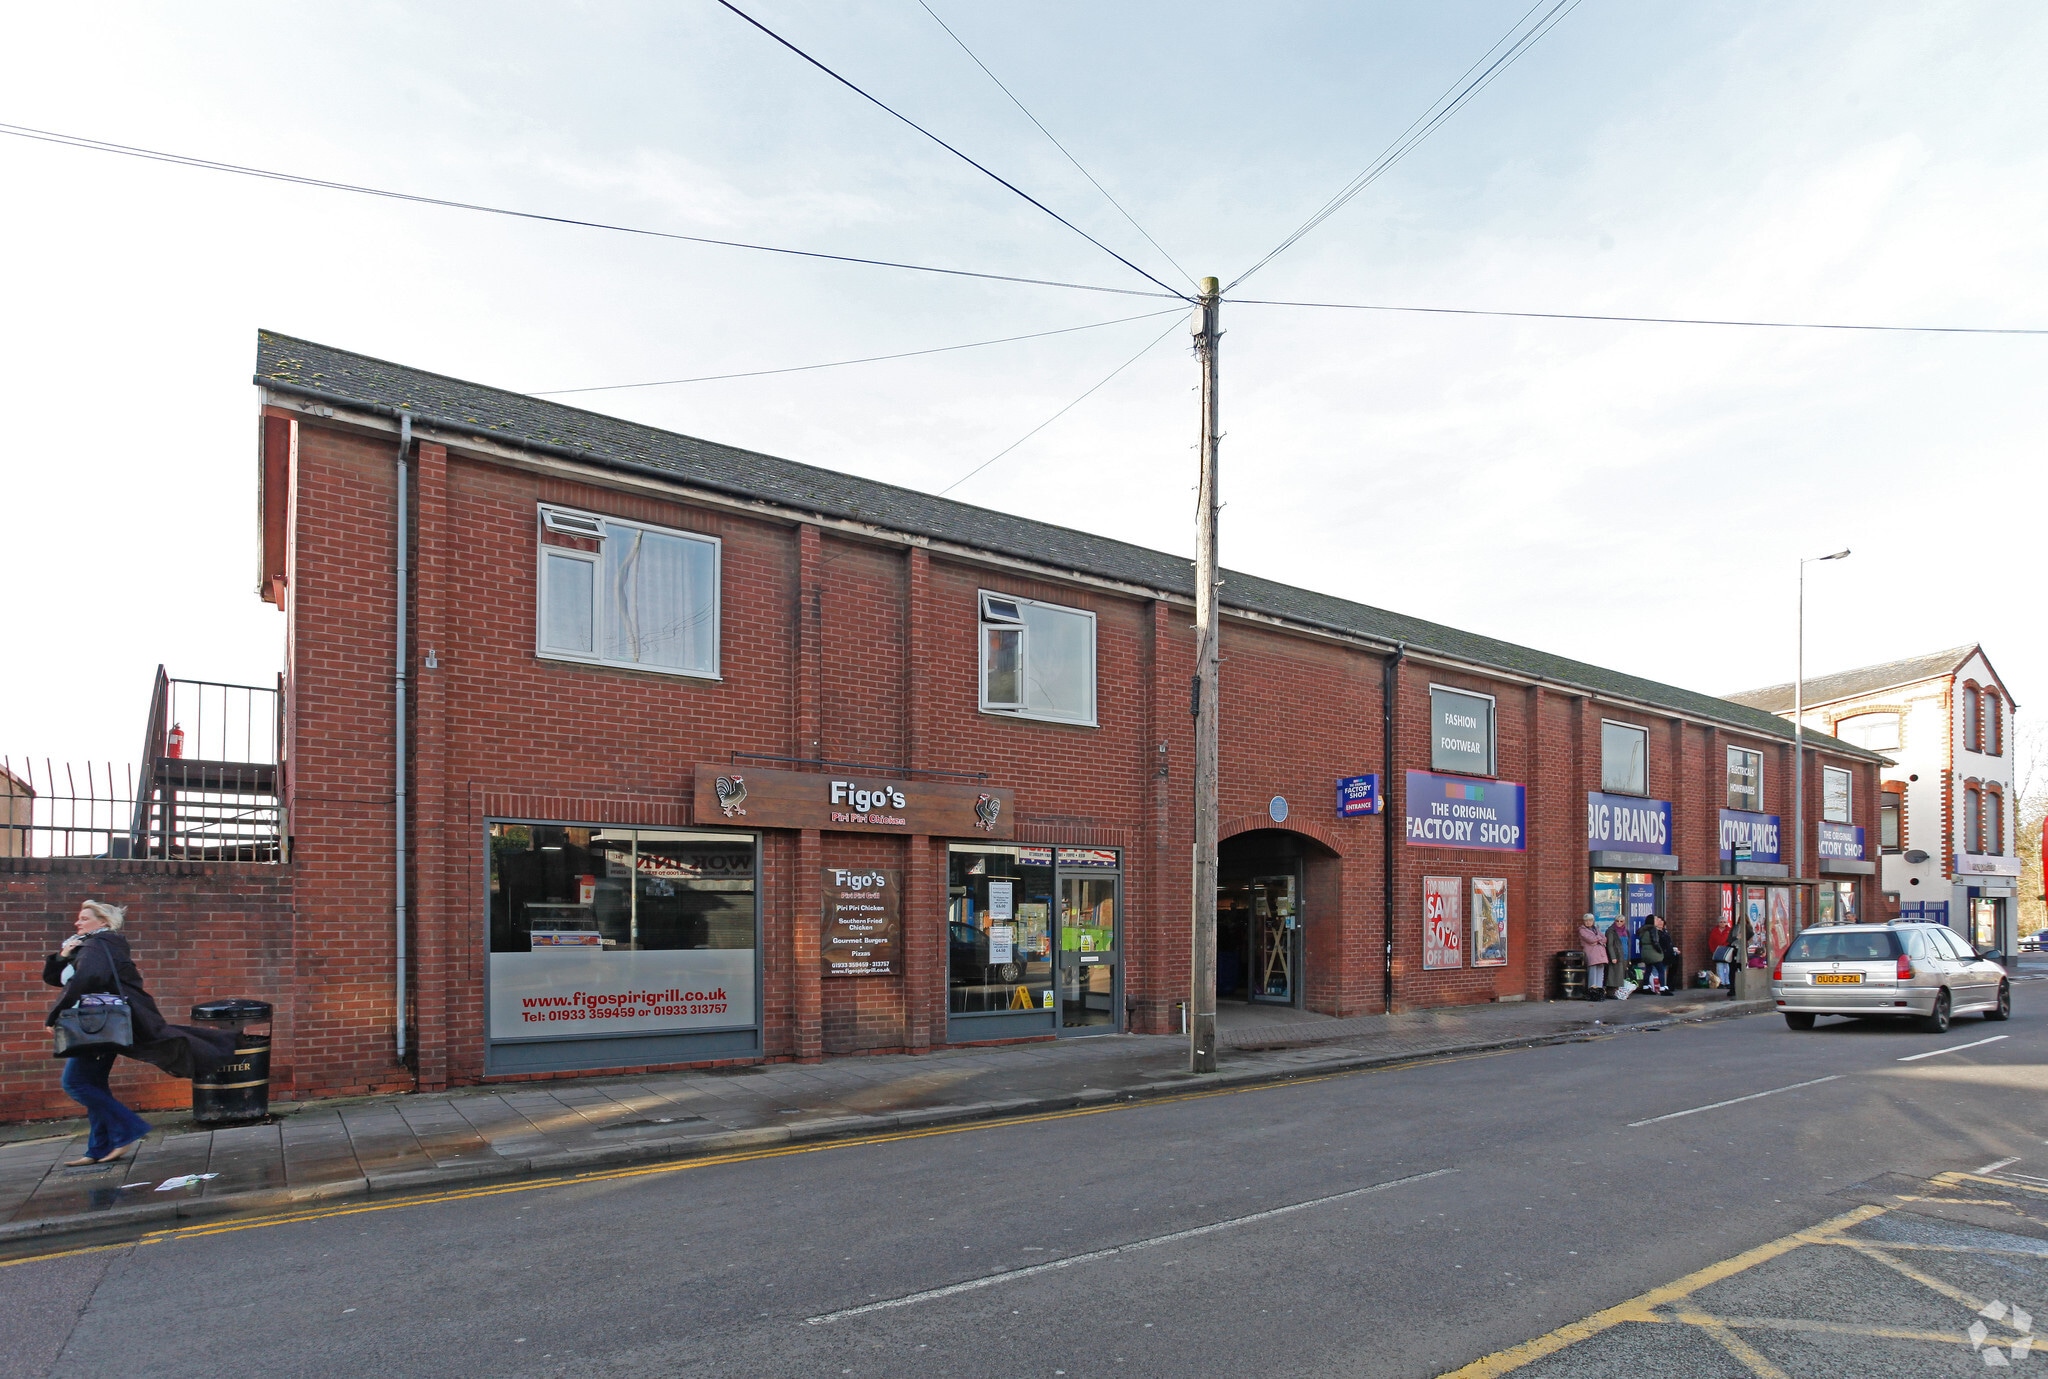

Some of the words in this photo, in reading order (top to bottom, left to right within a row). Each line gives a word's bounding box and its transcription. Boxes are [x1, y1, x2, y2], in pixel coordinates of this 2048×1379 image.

[1445, 713, 1477, 729] FASHION
[1441, 737, 1481, 754] FOOTWEAR
[1731, 765, 1754, 777] ELECTRICALS
[831, 781, 906, 812] Figo's
[1344, 784, 1371, 794] FACTORY
[1730, 783, 1755, 795] HOMEWARES
[1345, 802, 1371, 811] ENTRANCE
[1431, 802, 1449, 817] THE
[1452, 804, 1497, 821] ORIGINAL
[831, 812, 849, 822] Piri
[850, 813, 868, 823] Piri
[1588, 803, 1610, 840] BIG
[1614, 806, 1666, 845] BRANDS
[1406, 816, 1474, 841] FACTORY
[1480, 823, 1520, 844] SHOP
[1752, 822, 1778, 854] PRICES
[1823, 830, 1832, 839] THE
[1844, 843, 1862, 857] SHOP
[835, 871, 885, 890] Figo's
[1428, 896, 1458, 919] SAVE
[1427, 921, 1458, 948] 50%
[1427, 950, 1442, 965] OFF
[1817, 975, 1840, 983] OU02
[1842, 975, 1859, 983] EZL
[522, 987, 727, 1009] www.figospirigrill.co.uk
[522, 1011, 546, 1022] Tel:
[549, 1009, 586, 1021] 01933
[589, 1007, 635, 1019] 359459
[638, 1009, 651, 1017] or
[653, 1005, 688, 1016] 01933
[690, 1003, 728, 1014] 313757
